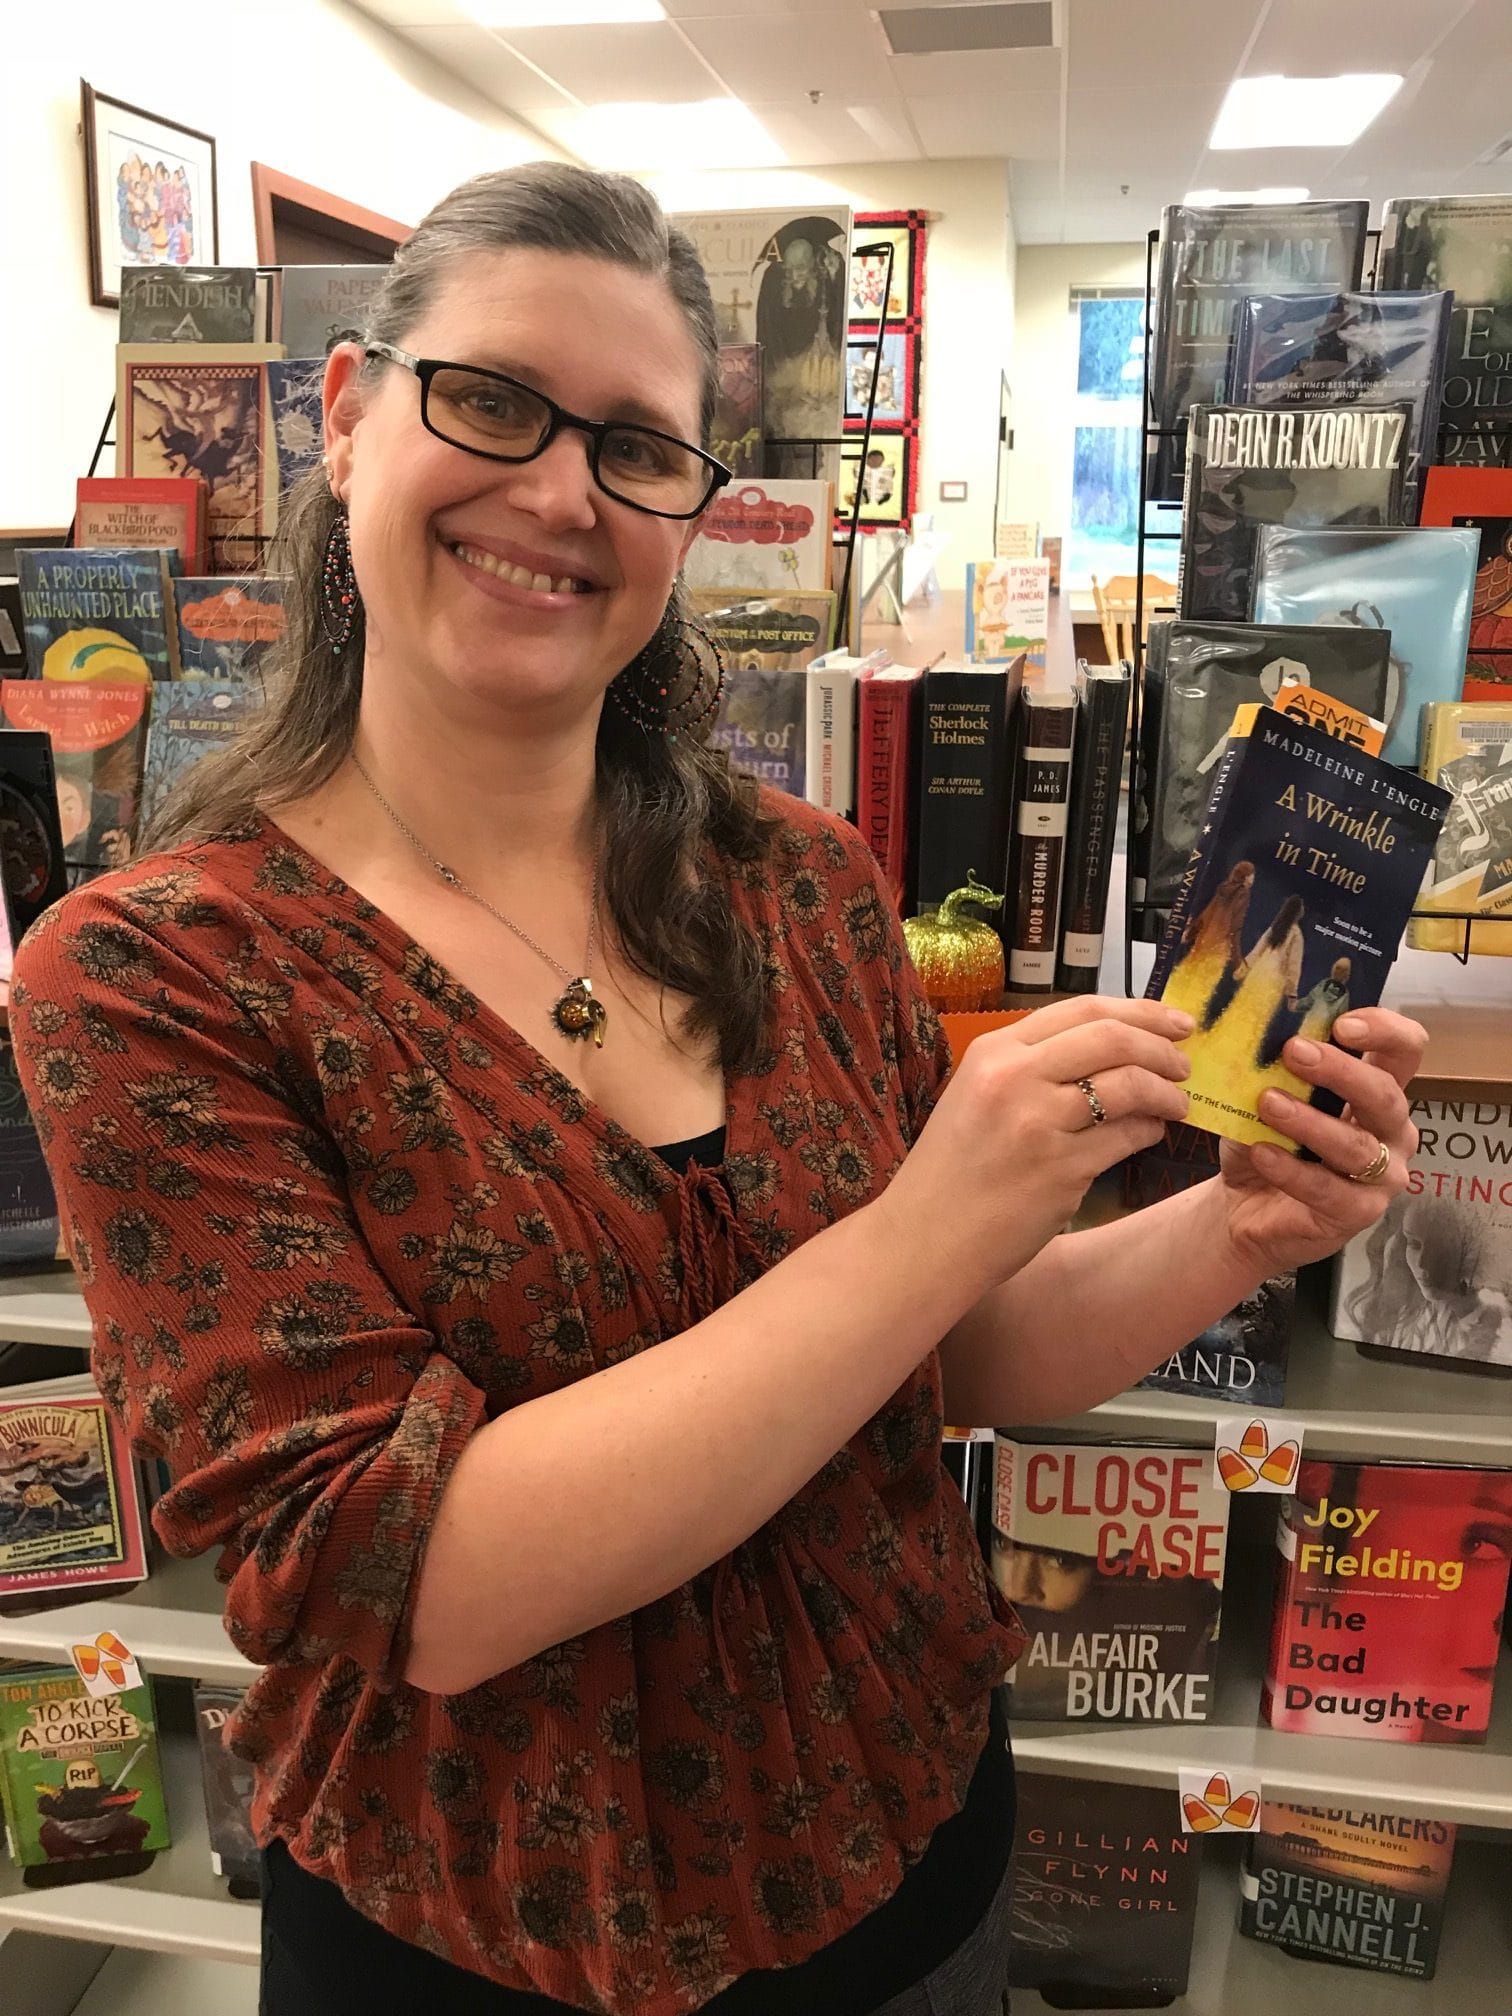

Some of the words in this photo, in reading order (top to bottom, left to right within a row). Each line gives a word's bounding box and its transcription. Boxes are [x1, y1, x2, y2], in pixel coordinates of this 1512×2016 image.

[1176, 299, 1236, 337] TIM
[1302, 381, 1326, 389] TIMES
[1206, 413, 1280, 470] DEAN
[1273, 414, 1298, 470] R.
[1298, 413, 1407, 470] KOONTZ
[89, 524, 146, 536] BLACKBIRD
[148, 525, 177, 537] POND
[108, 513, 144, 525] WITCH
[37, 566, 50, 589] A
[53, 564, 139, 590] PROPERLY
[22, 591, 112, 619] UNHAUNTED
[115, 591, 160, 619] PLACE
[758, 630, 782, 641] POST
[783, 630, 815, 642] OFFICE
[97, 688, 139, 702] JONES
[820, 686, 833, 720] JURASSIC
[928, 703, 946, 712] THE
[948, 703, 991, 713] COMPLETE
[929, 715, 989, 730] Sherlock
[1291, 693, 1369, 735] ADMIT
[764, 723, 796, 749] of
[820, 720, 833, 739] PARK
[932, 731, 985, 745] Holmes
[871, 708, 893, 807] JEFFERY
[946, 777, 982, 786] ARTHUR
[1033, 784, 1060, 794] JAMES
[1038, 770, 1045, 781] P.
[1049, 771, 1058, 781] D.
[1263, 728, 1365, 787] MADELEINE
[1371, 779, 1440, 822] L'ENGLE
[928, 786, 957, 794] CONAN
[1275, 784, 1297, 812] A
[1305, 791, 1397, 855] Wrinkle
[871, 817, 890, 876] DEA
[1031, 851, 1047, 904] MURDER
[1275, 832, 1301, 867] in
[1306, 848, 1368, 895] Time
[1028, 908, 1044, 944] ROOM
[1358, 942, 1383, 957] picture
[1192, 1093, 1204, 1102] OF
[1204, 1097, 1220, 1109] THE
[1219, 1103, 1257, 1121] NEWBERY
[1416, 1128, 1512, 1165] ROW
[1148, 1352, 1257, 1390] AND
[0, 1415, 77, 1444] BUNNICULA
[1025, 1454, 1203, 1519] CLOSE
[1303, 1497, 1380, 1537] Joy
[1096, 1521, 1225, 1580] CASE
[9, 1571, 57, 1582] JAMES
[64, 1565, 109, 1577] HOWE
[1299, 1543, 1464, 1591] Fielding
[1295, 1600, 1367, 1632] The
[1027, 1632, 1159, 1671] ALAFAIR
[1288, 1642, 1366, 1675] Bad
[35, 1704, 62, 1722] TO
[70, 1698, 119, 1719] KICK
[1066, 1670, 1210, 1721] BURKE
[1284, 1683, 1470, 1723] Daughter
[20, 1729, 39, 1748] A
[45, 1716, 135, 1744] CORPSE
[69, 1767, 96, 1782] RIP
[1028, 1828, 1188, 1854] GILLIAN
[1310, 1824, 1338, 1837] SHANE
[1342, 1831, 1376, 1845] SCULLY
[1379, 1840, 1409, 1853] NOVEL
[1045, 1860, 1168, 1884] FLYNN
[1031, 1890, 1101, 1907] GONE
[1118, 1898, 1178, 1911] GIRL
[1260, 1867, 1396, 1926] STEPHEN
[1403, 1902, 1430, 1931] J.
[1256, 1900, 1426, 1968] CANNELL
[1271, 1934, 1287, 1943] YORK
[1289, 1938, 1308, 1948] TIMES
